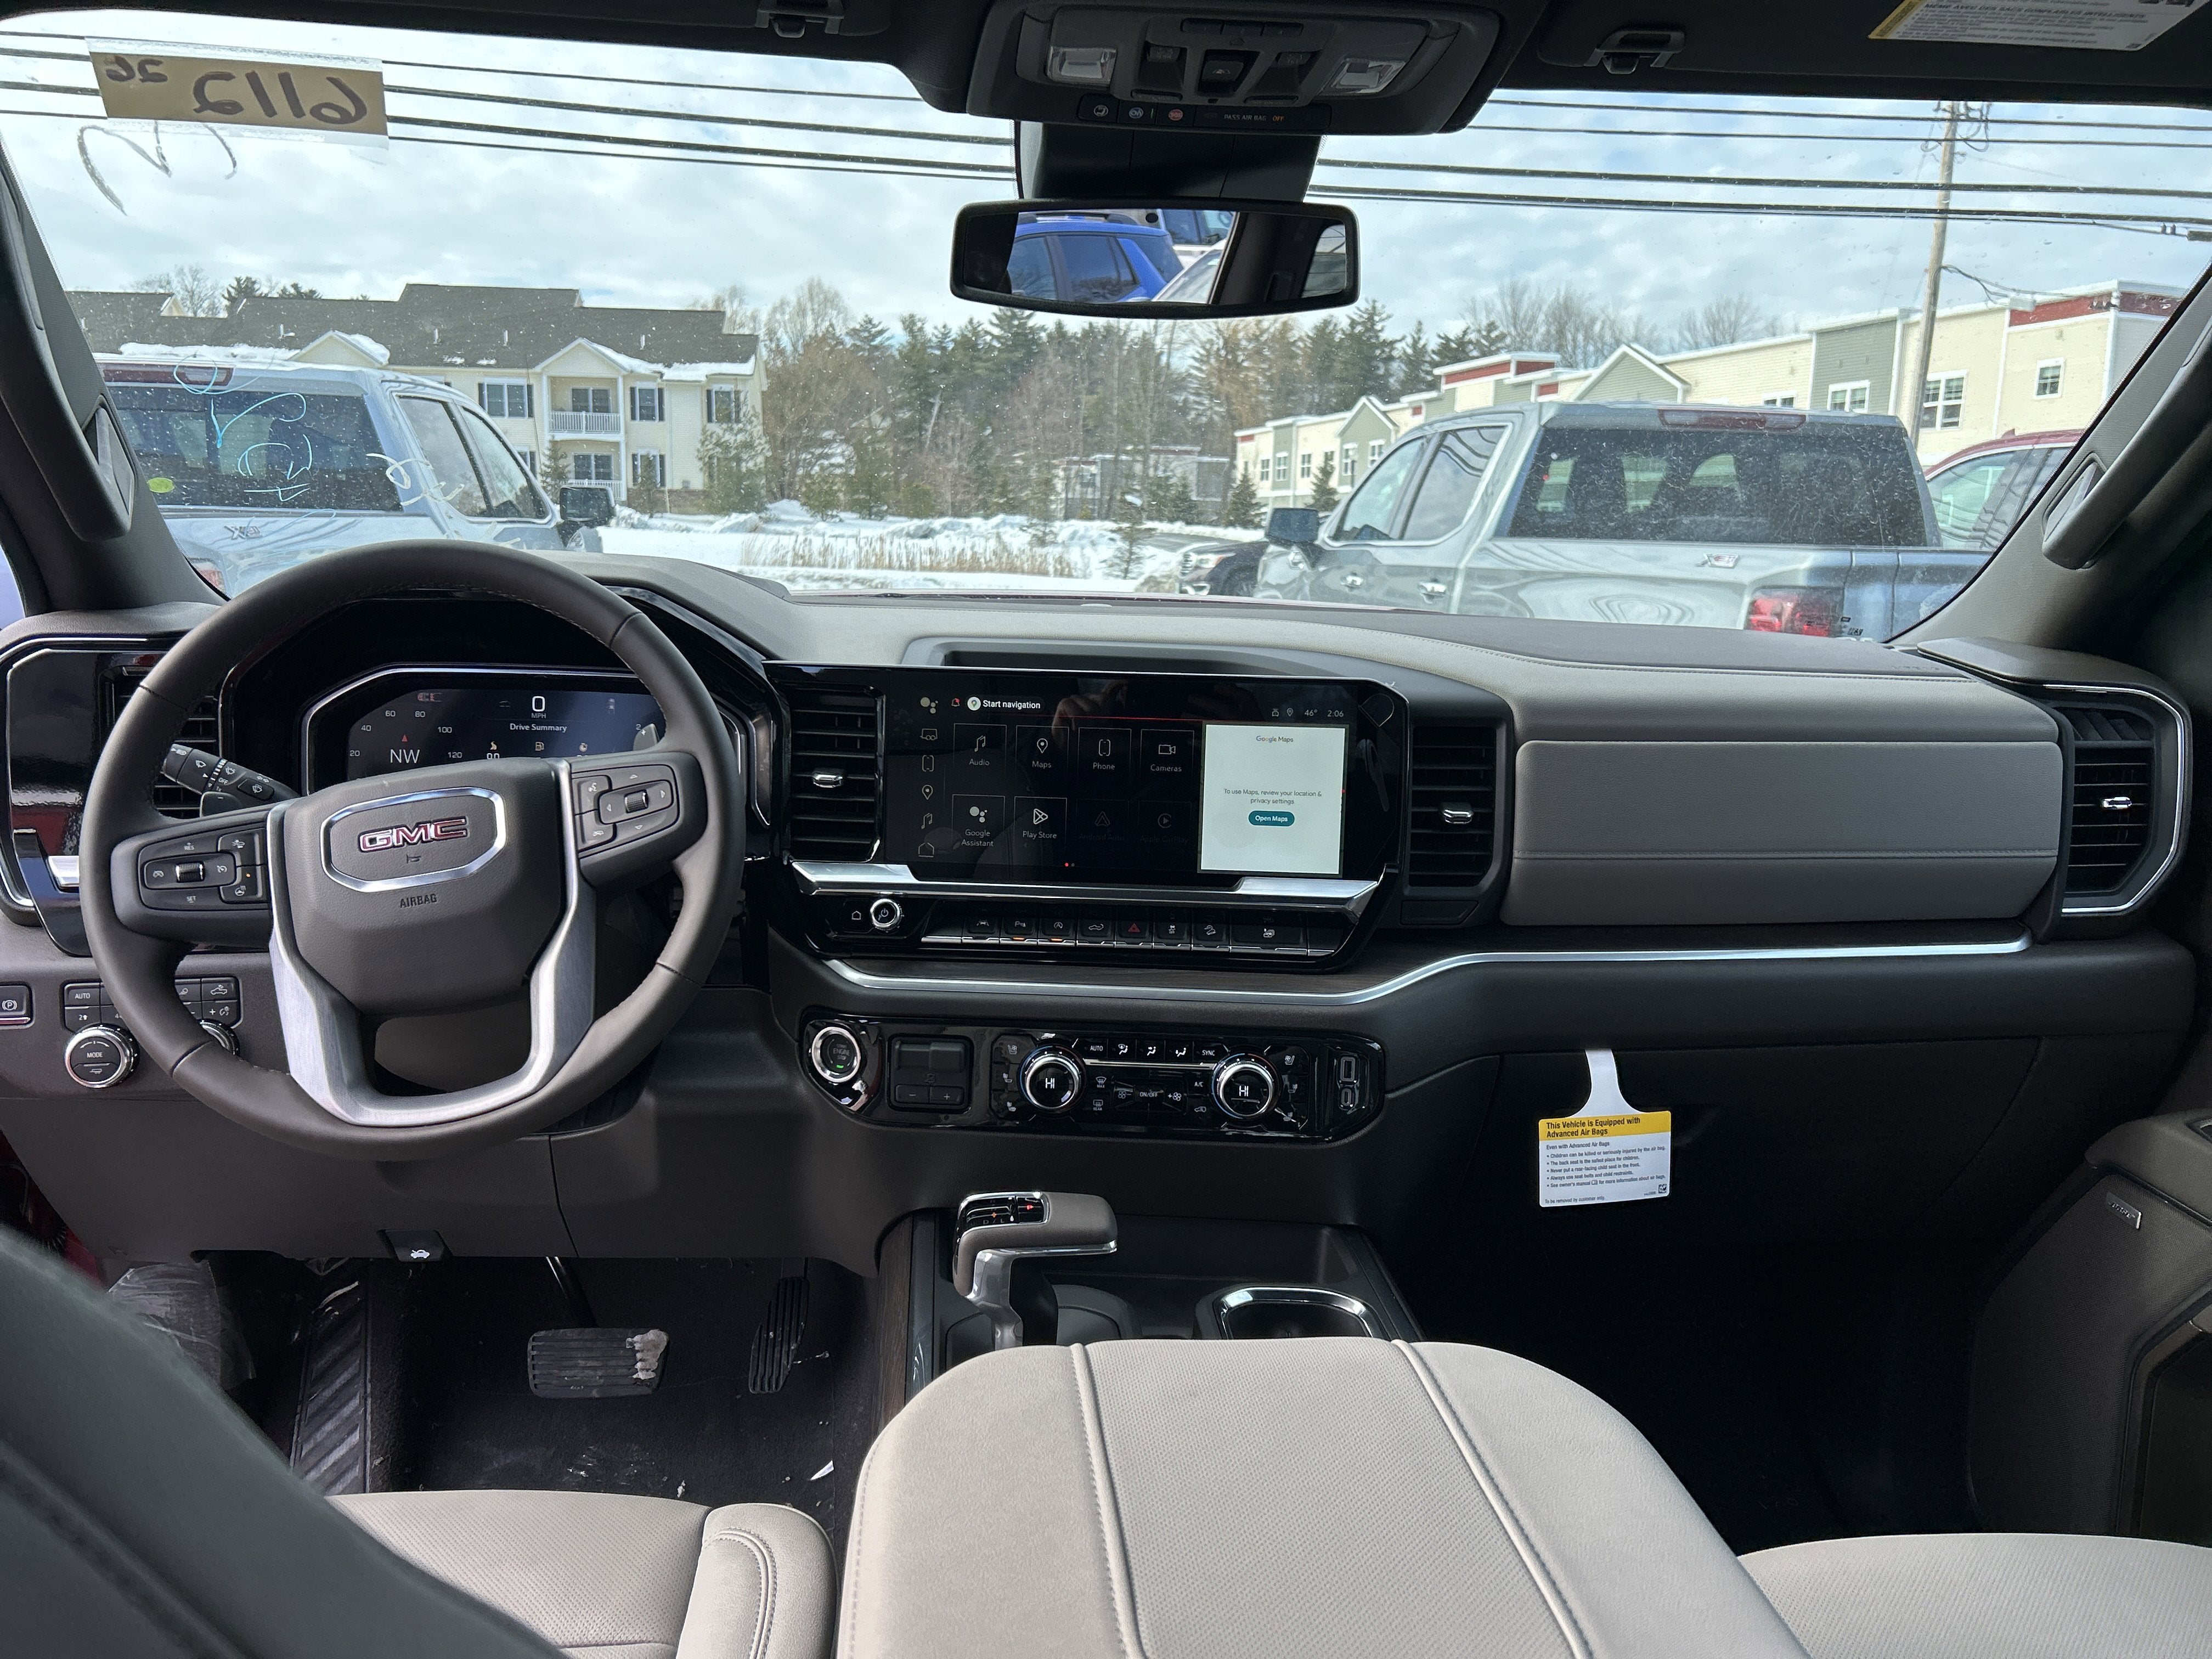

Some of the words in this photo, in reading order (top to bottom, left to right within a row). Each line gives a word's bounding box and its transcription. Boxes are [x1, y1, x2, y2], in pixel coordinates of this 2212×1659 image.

[532, 696, 546, 712] 0
[983, 699, 1001, 708] Start
[1002, 701, 1041, 710] navigation
[510, 723, 530, 731] Drive
[531, 723, 567, 732] Summary
[390, 749, 420, 763] NW
[1031, 760, 1052, 769] Maps
[1092, 762, 1115, 770] Phone
[1150, 764, 1182, 772] Cameras
[358, 816, 468, 852] GMC
[965, 829, 990, 838] Google
[1022, 831, 1037, 839] Play
[399, 893, 438, 909] AIRBAG
[833, 1048, 850, 1057] ENGINE
[1045, 1077, 1055, 1089] HI
[1239, 1085, 1249, 1097] HI
[1562, 1120, 1585, 1128] Vehicle
[1595, 1118, 1625, 1127] Equipped
[1547, 1130, 1579, 1138] Advanced
